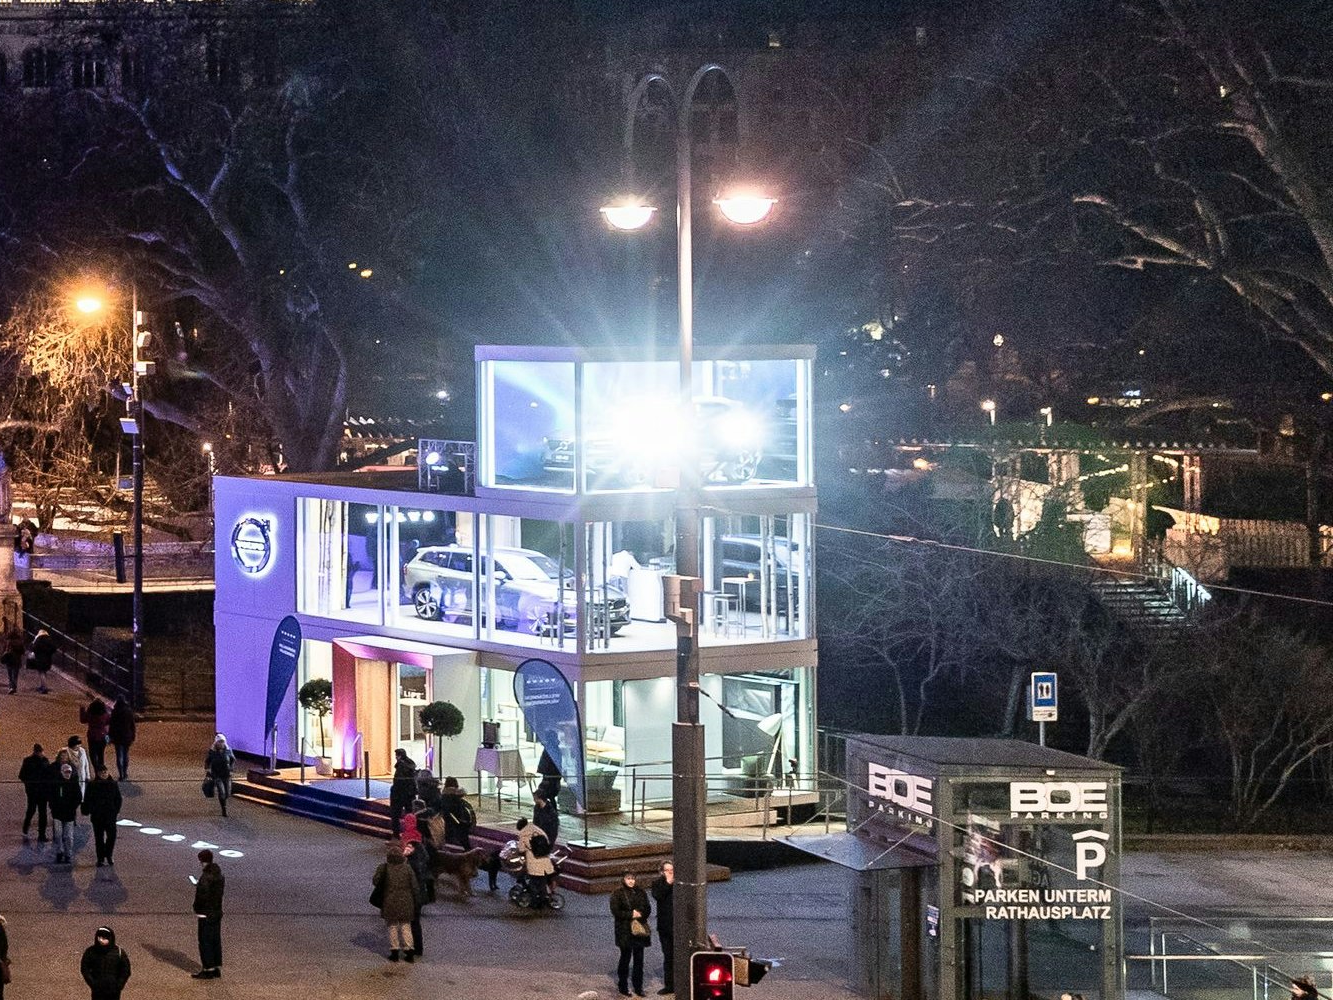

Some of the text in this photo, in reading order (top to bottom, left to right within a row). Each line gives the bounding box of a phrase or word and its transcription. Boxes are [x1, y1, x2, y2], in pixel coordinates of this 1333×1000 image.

[868, 762, 932, 814] BOE
[1010, 782, 1108, 812] BOE
[868, 800, 933, 828] PARKING
[1076, 842, 1106, 880] P
[975, 889, 1111, 902] PARKEN UNTERM
[986, 906, 1111, 920] RATHAUSPLATZ
